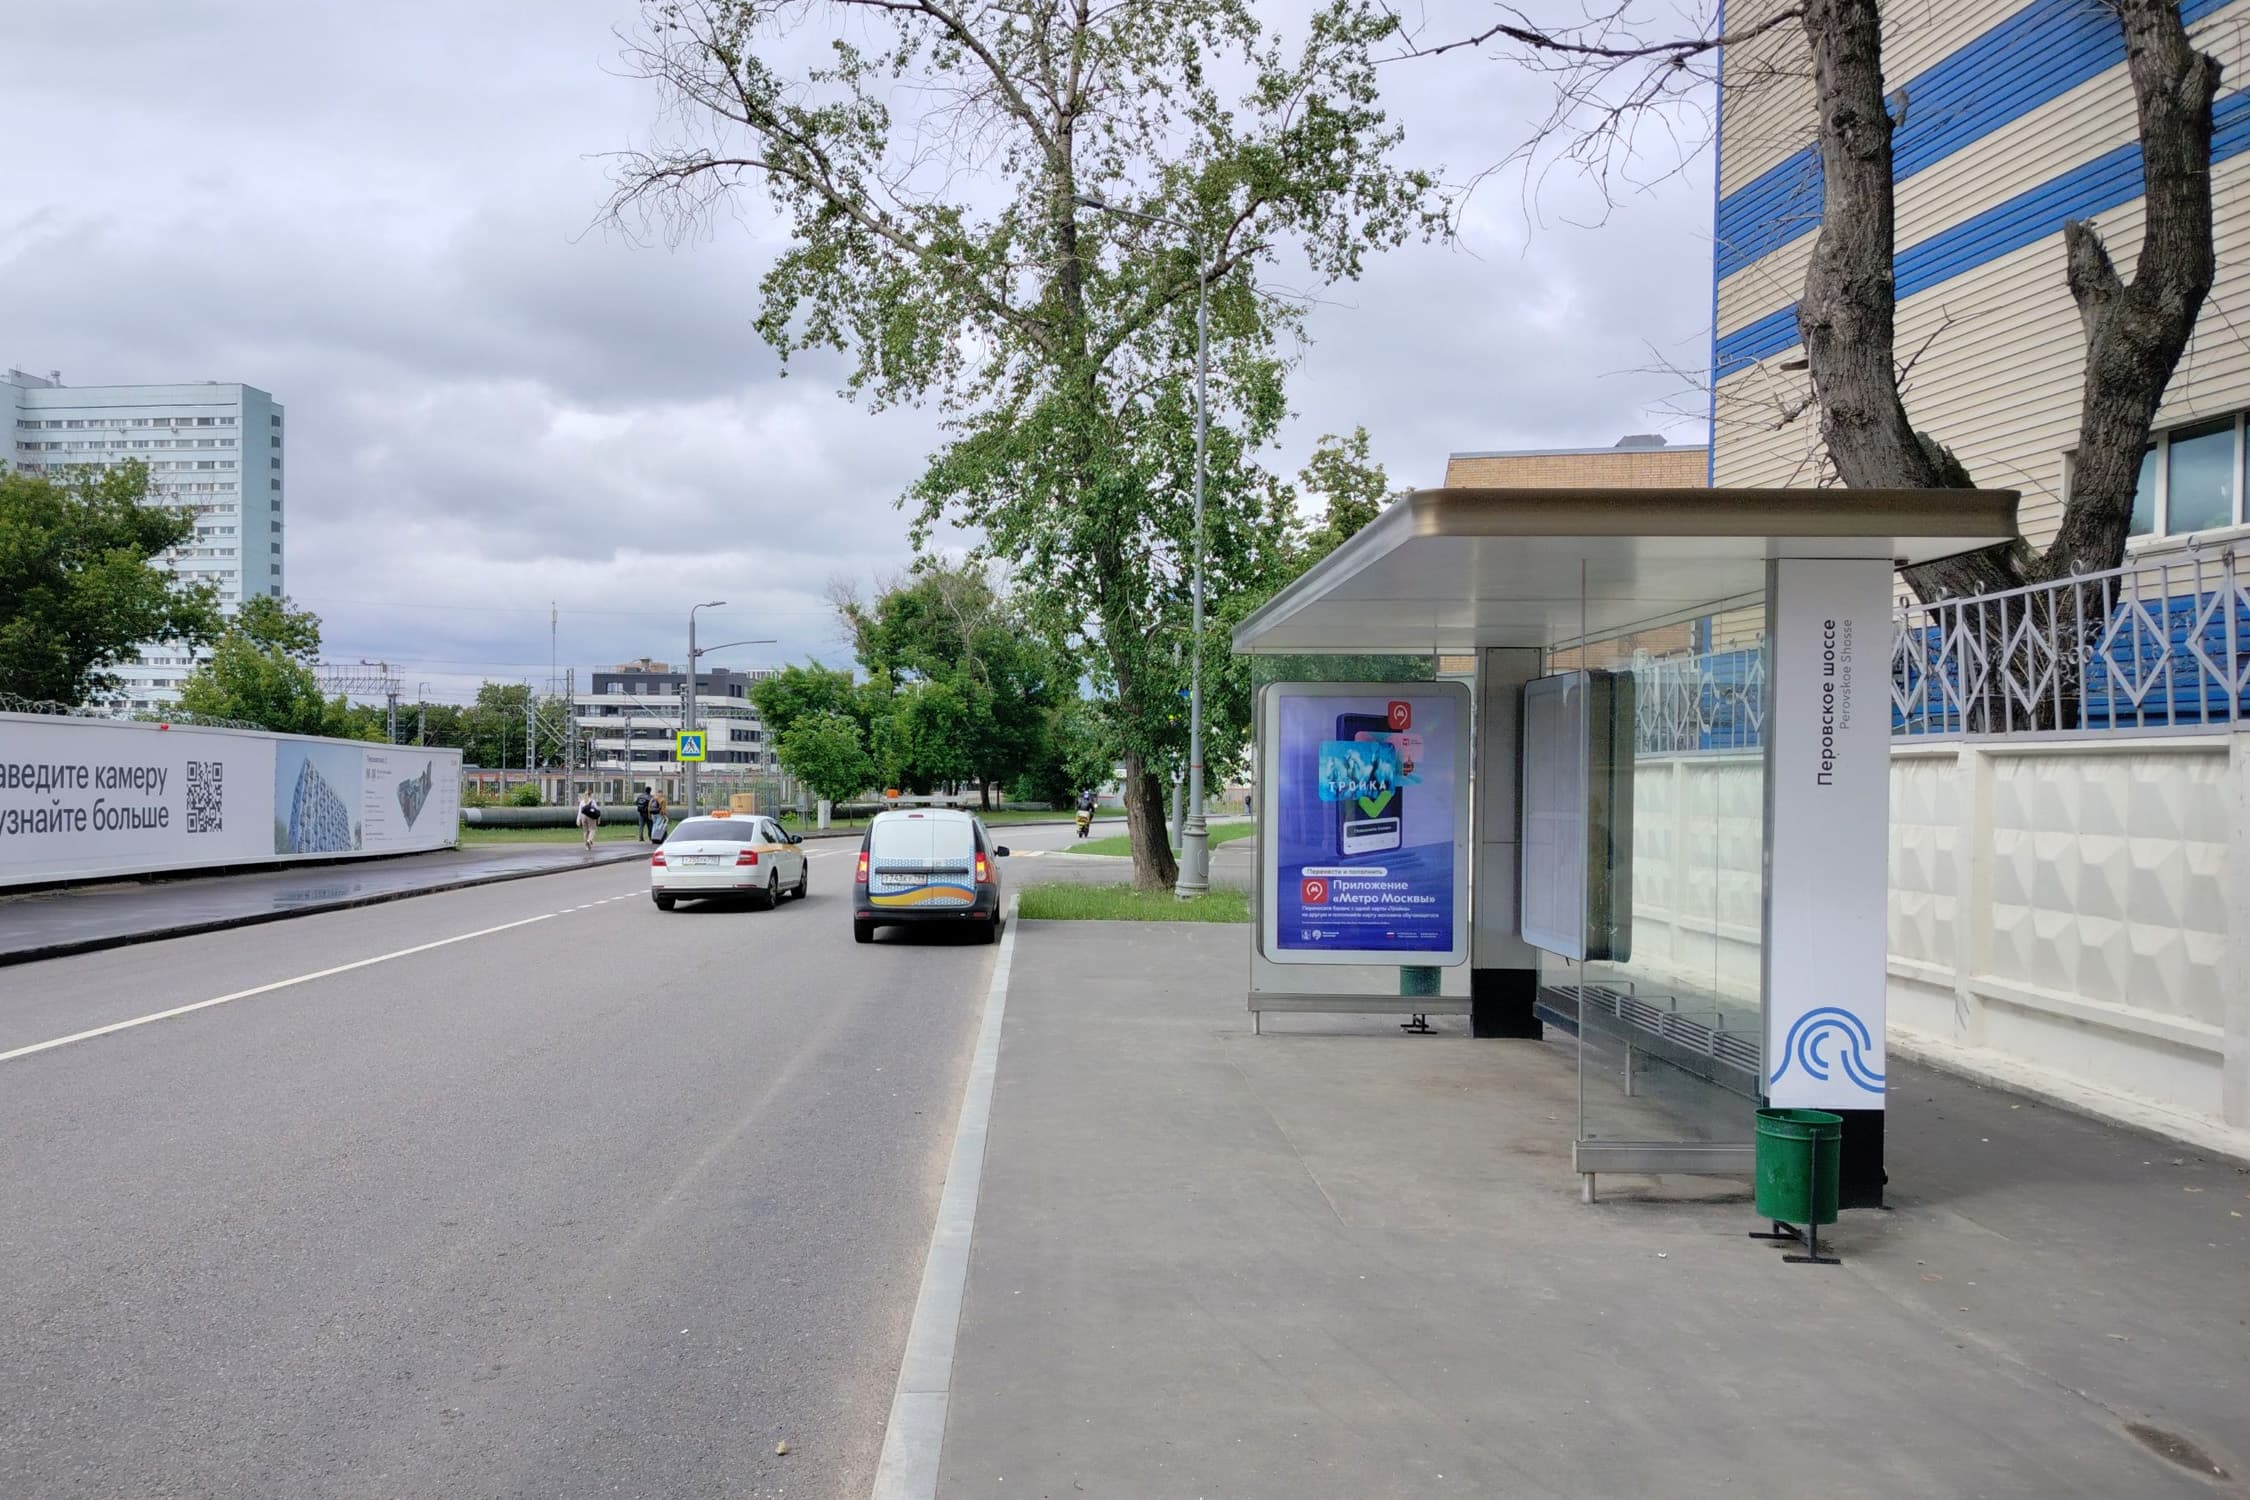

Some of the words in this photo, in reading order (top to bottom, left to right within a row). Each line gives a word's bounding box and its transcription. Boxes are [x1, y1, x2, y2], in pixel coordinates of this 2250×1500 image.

[1823, 619, 1836, 677] шоссе
[1841, 619, 1852, 663] Shosse
[1840, 666, 1852, 730] Perovskoe
[1817, 682, 1836, 786] Перовское
[95, 765, 168, 796] камеру
[92, 798, 169, 831] больше
[1333, 880, 1409, 892] Приложение
[1333, 893, 1379, 904] «Метро
[1381, 893, 1436, 904] Москвы»
